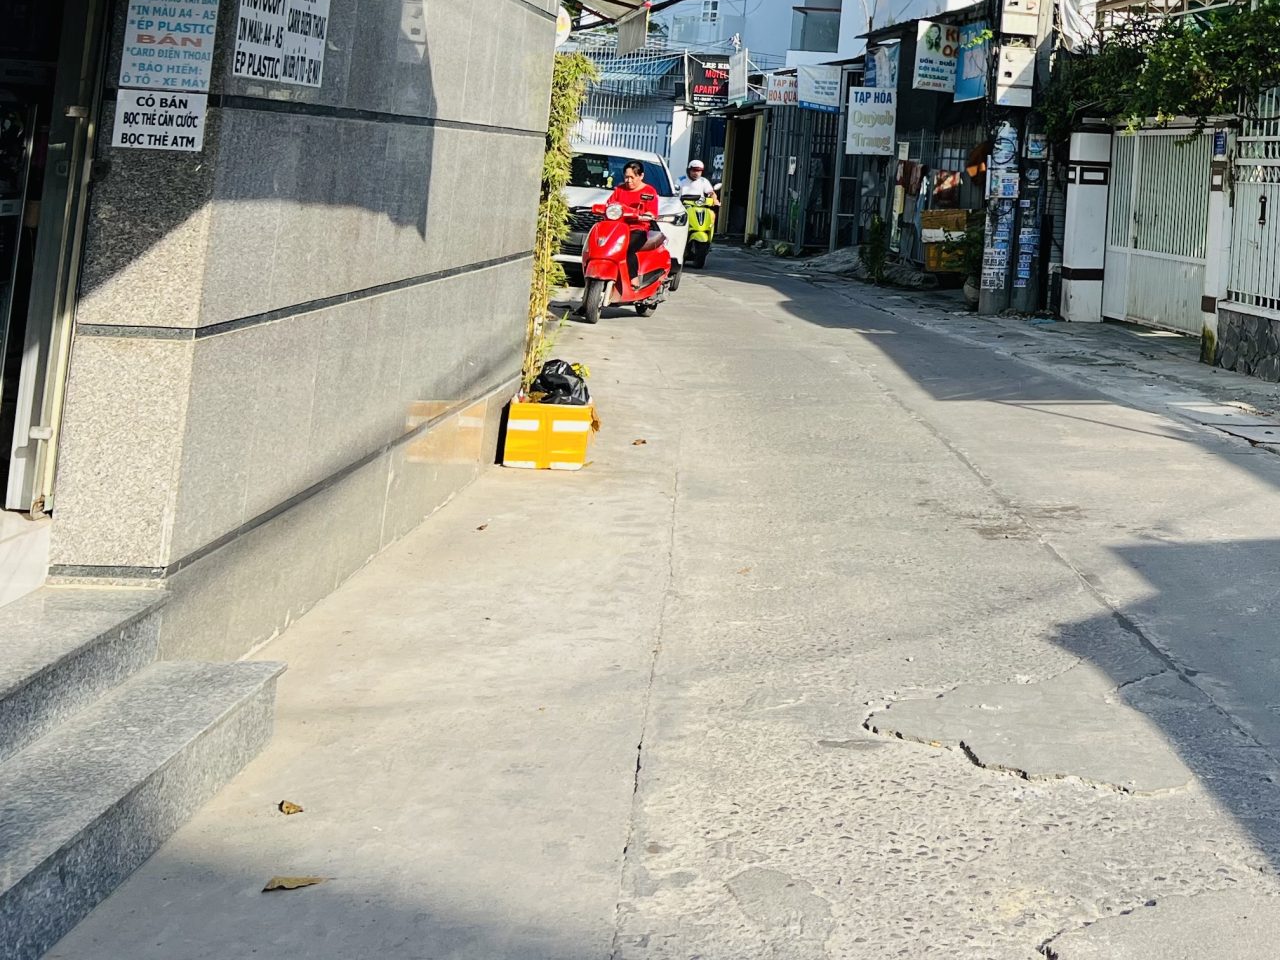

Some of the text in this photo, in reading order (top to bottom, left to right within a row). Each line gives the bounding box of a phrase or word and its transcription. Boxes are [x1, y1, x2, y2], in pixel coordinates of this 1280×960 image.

[178, 8, 192, 19] A4
[203, 10, 216, 20] A5
[157, 21, 214, 35] PLASTIC
[136, 33, 202, 47] BÁN
[247, 52, 280, 79] PLASTIC
[121, 72, 131, 84] Ô
[134, 73, 151, 85] TÔ
[162, 77, 177, 87] XE
[136, 94, 188, 109] CÓ BÁN
[854, 91, 871, 106] TẠP
[123, 112, 140, 127] BỌC
[158, 110, 174, 127] CĂN
[121, 131, 195, 148] BỌC THẺ ATM
